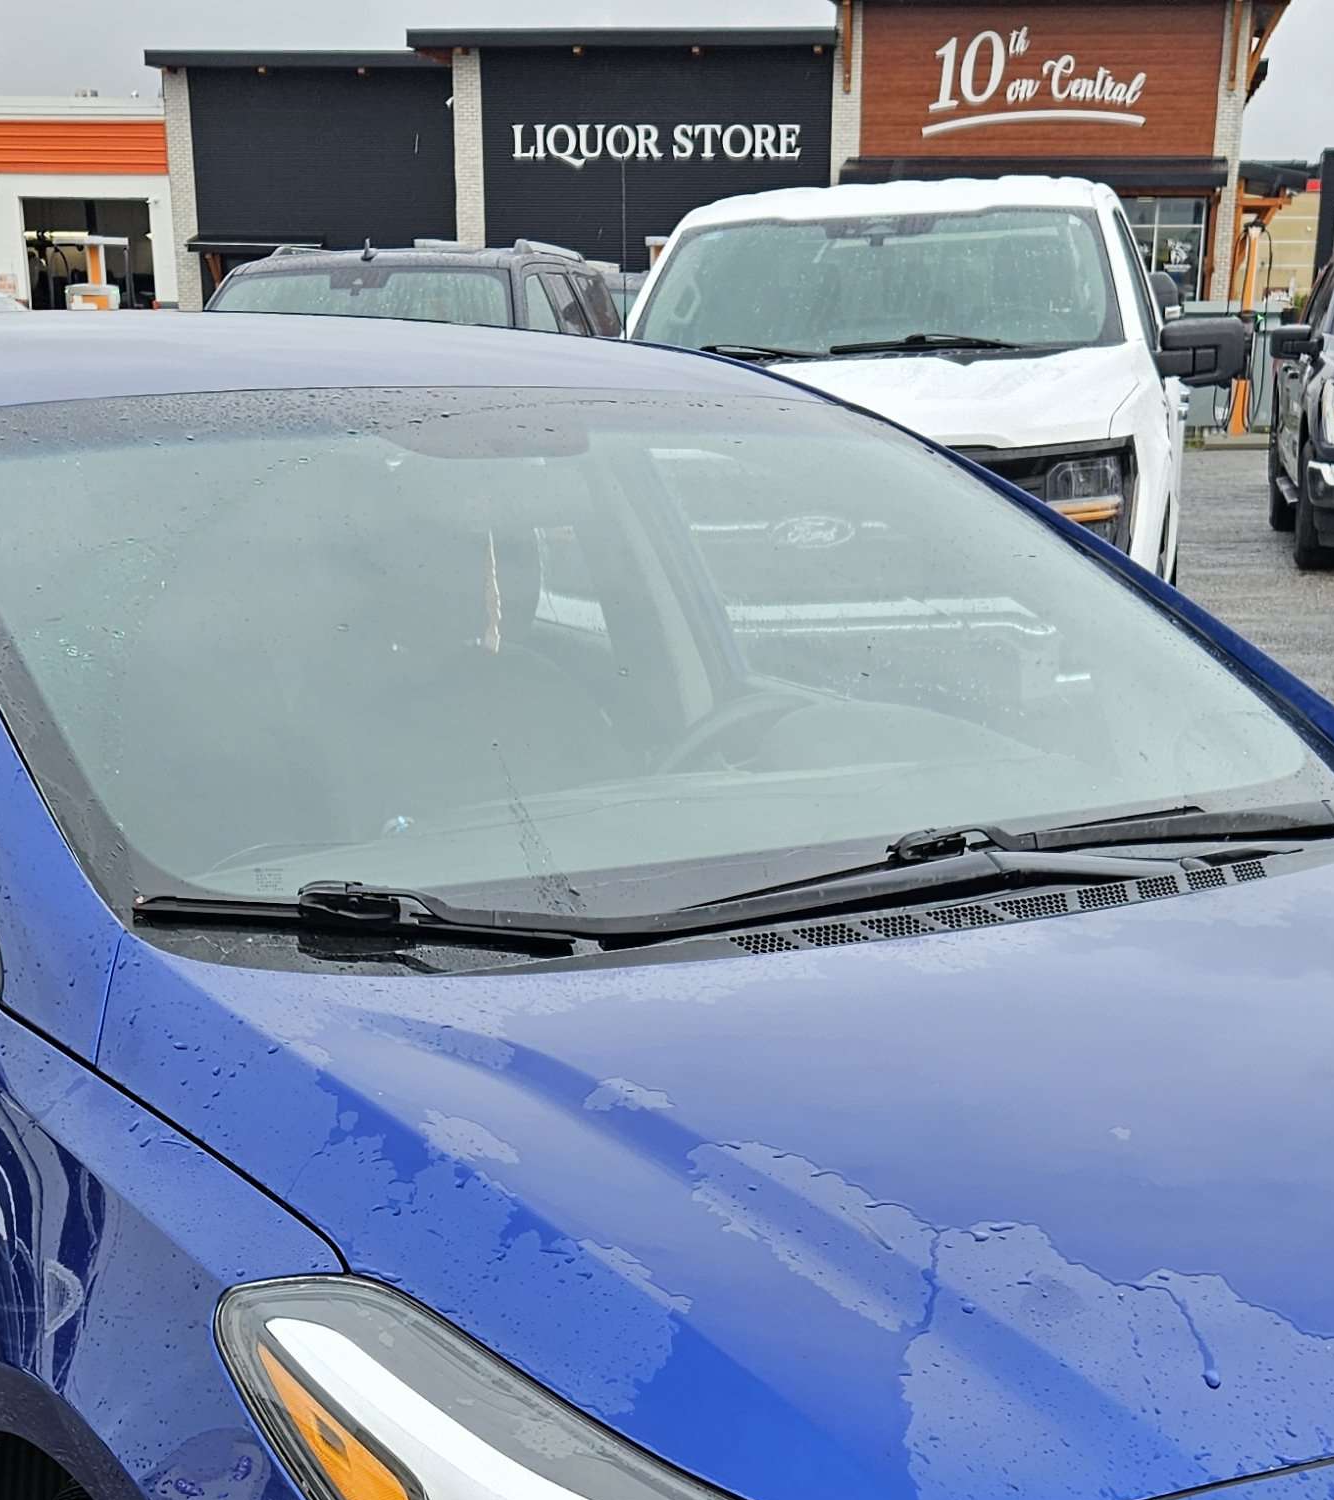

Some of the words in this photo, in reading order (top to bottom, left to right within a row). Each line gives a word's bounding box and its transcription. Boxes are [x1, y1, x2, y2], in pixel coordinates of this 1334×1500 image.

[1006, 77, 1041, 105] on
[1041, 54, 1147, 107] Central
[511, 124, 664, 169] LIQUOR
[672, 124, 802, 160] STORE
